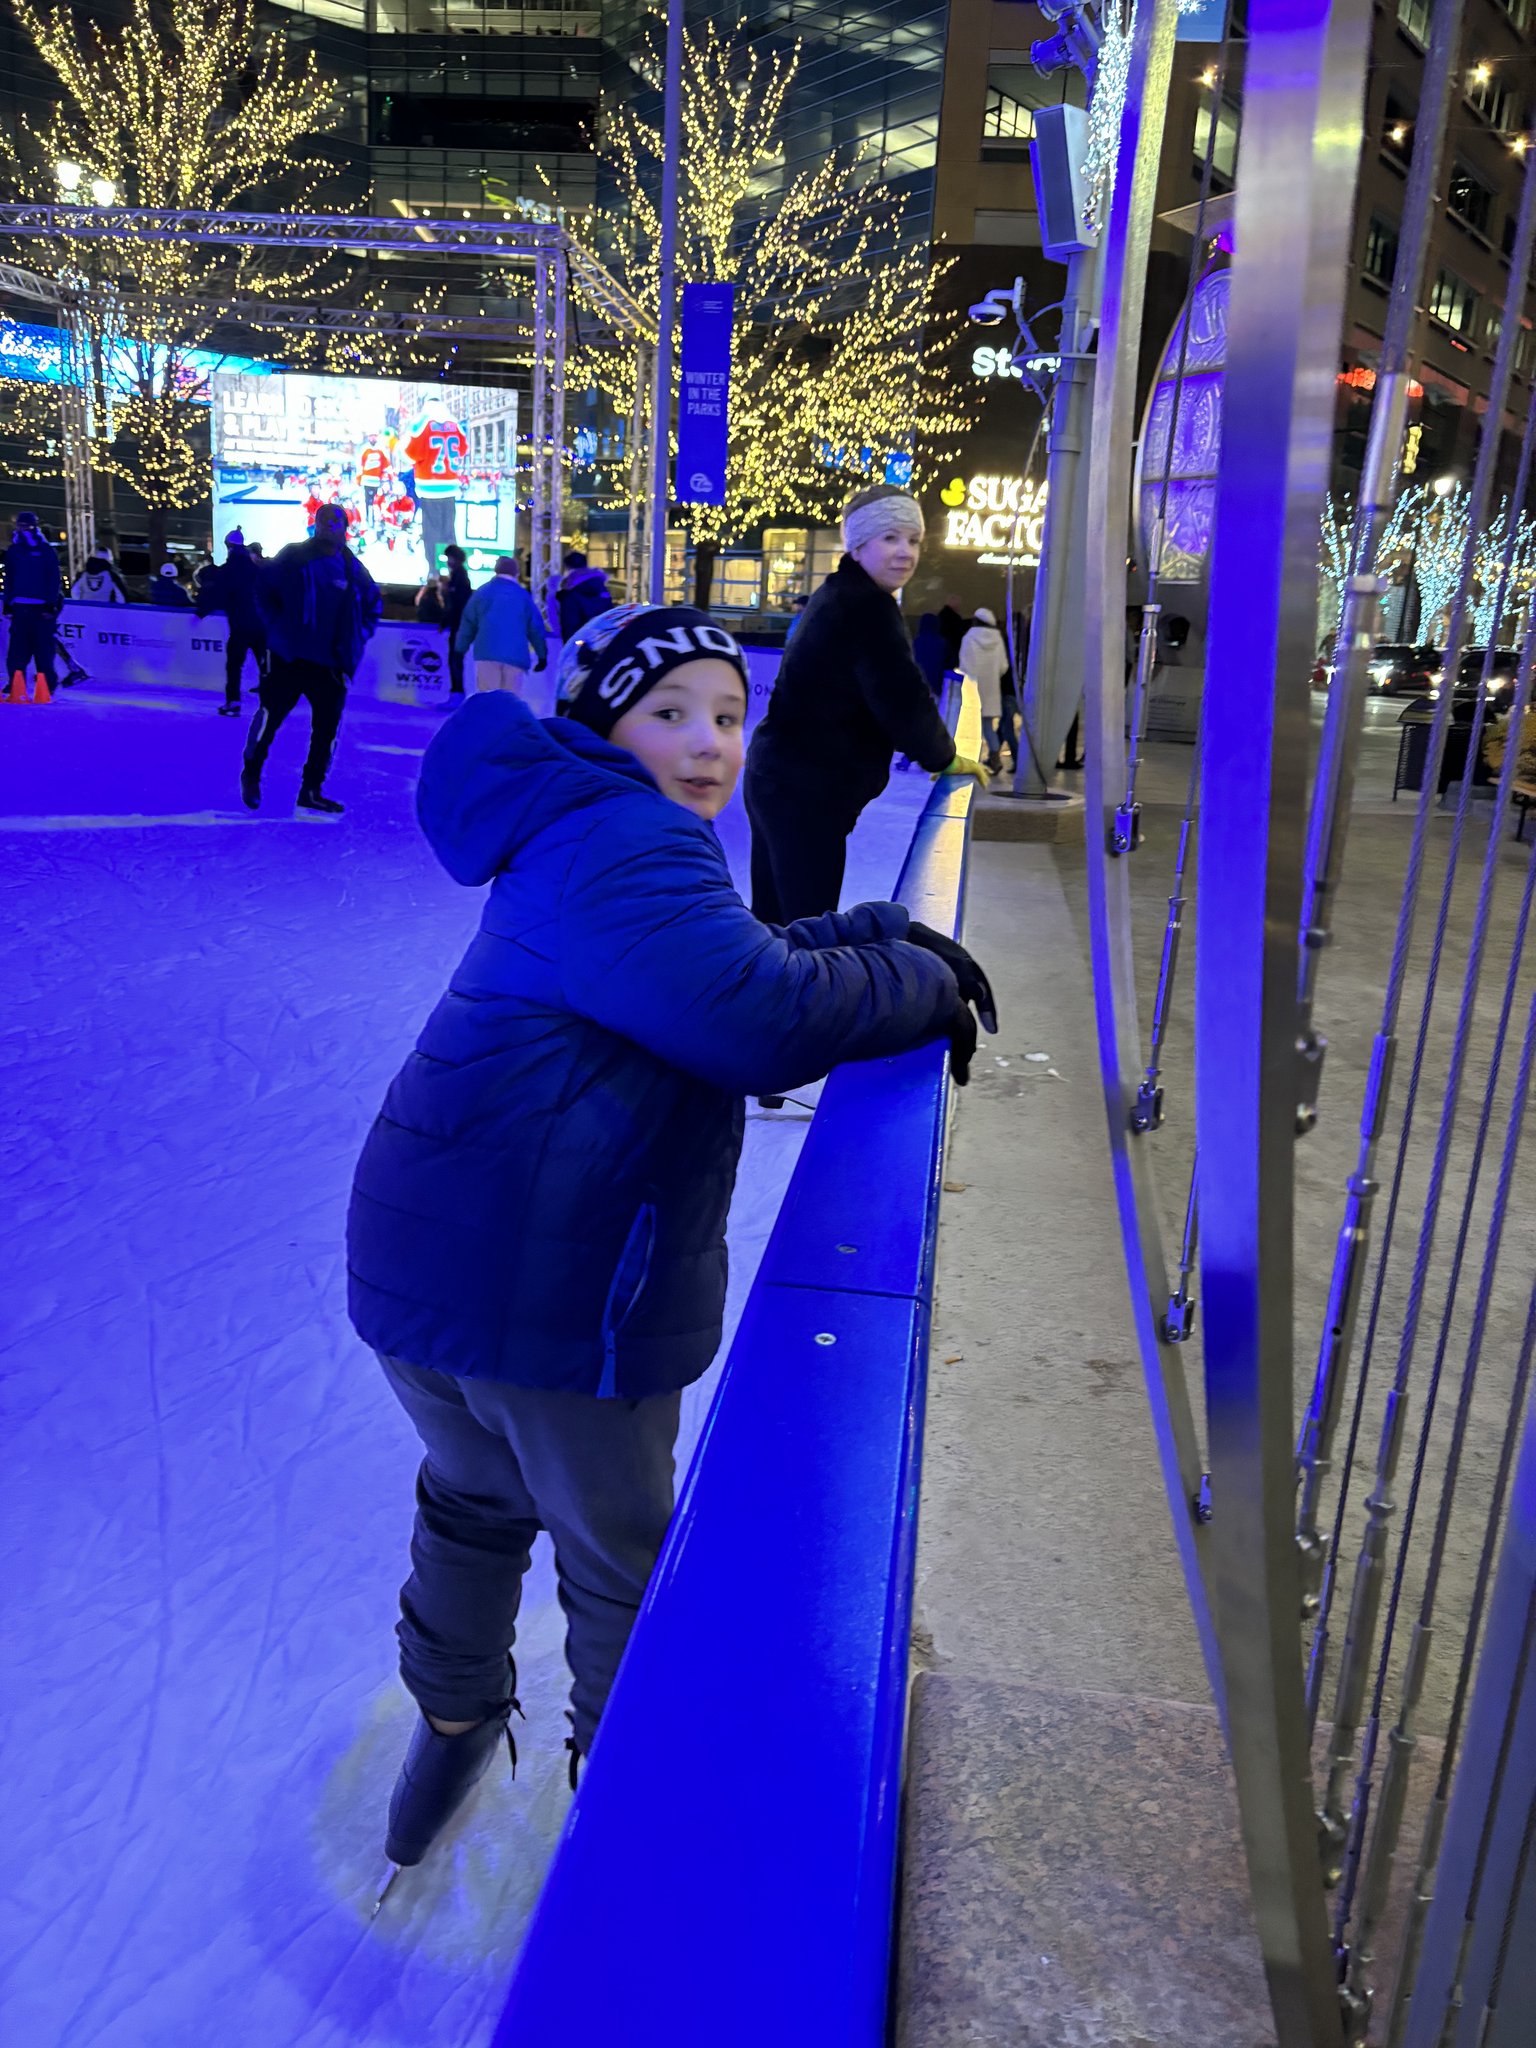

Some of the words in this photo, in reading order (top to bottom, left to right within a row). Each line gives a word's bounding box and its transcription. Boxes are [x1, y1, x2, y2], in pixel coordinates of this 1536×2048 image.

[685, 371, 726, 385] WINTER
[687, 387, 700, 400] IN
[701, 388, 722, 401] THE
[687, 402, 721, 416] PARKS
[967, 475, 1049, 513] SUGA
[945, 510, 1045, 550] FACTO
[98, 631, 132, 646] DTE
[191, 638, 223, 652] DTE
[598, 625, 748, 709] SNO
